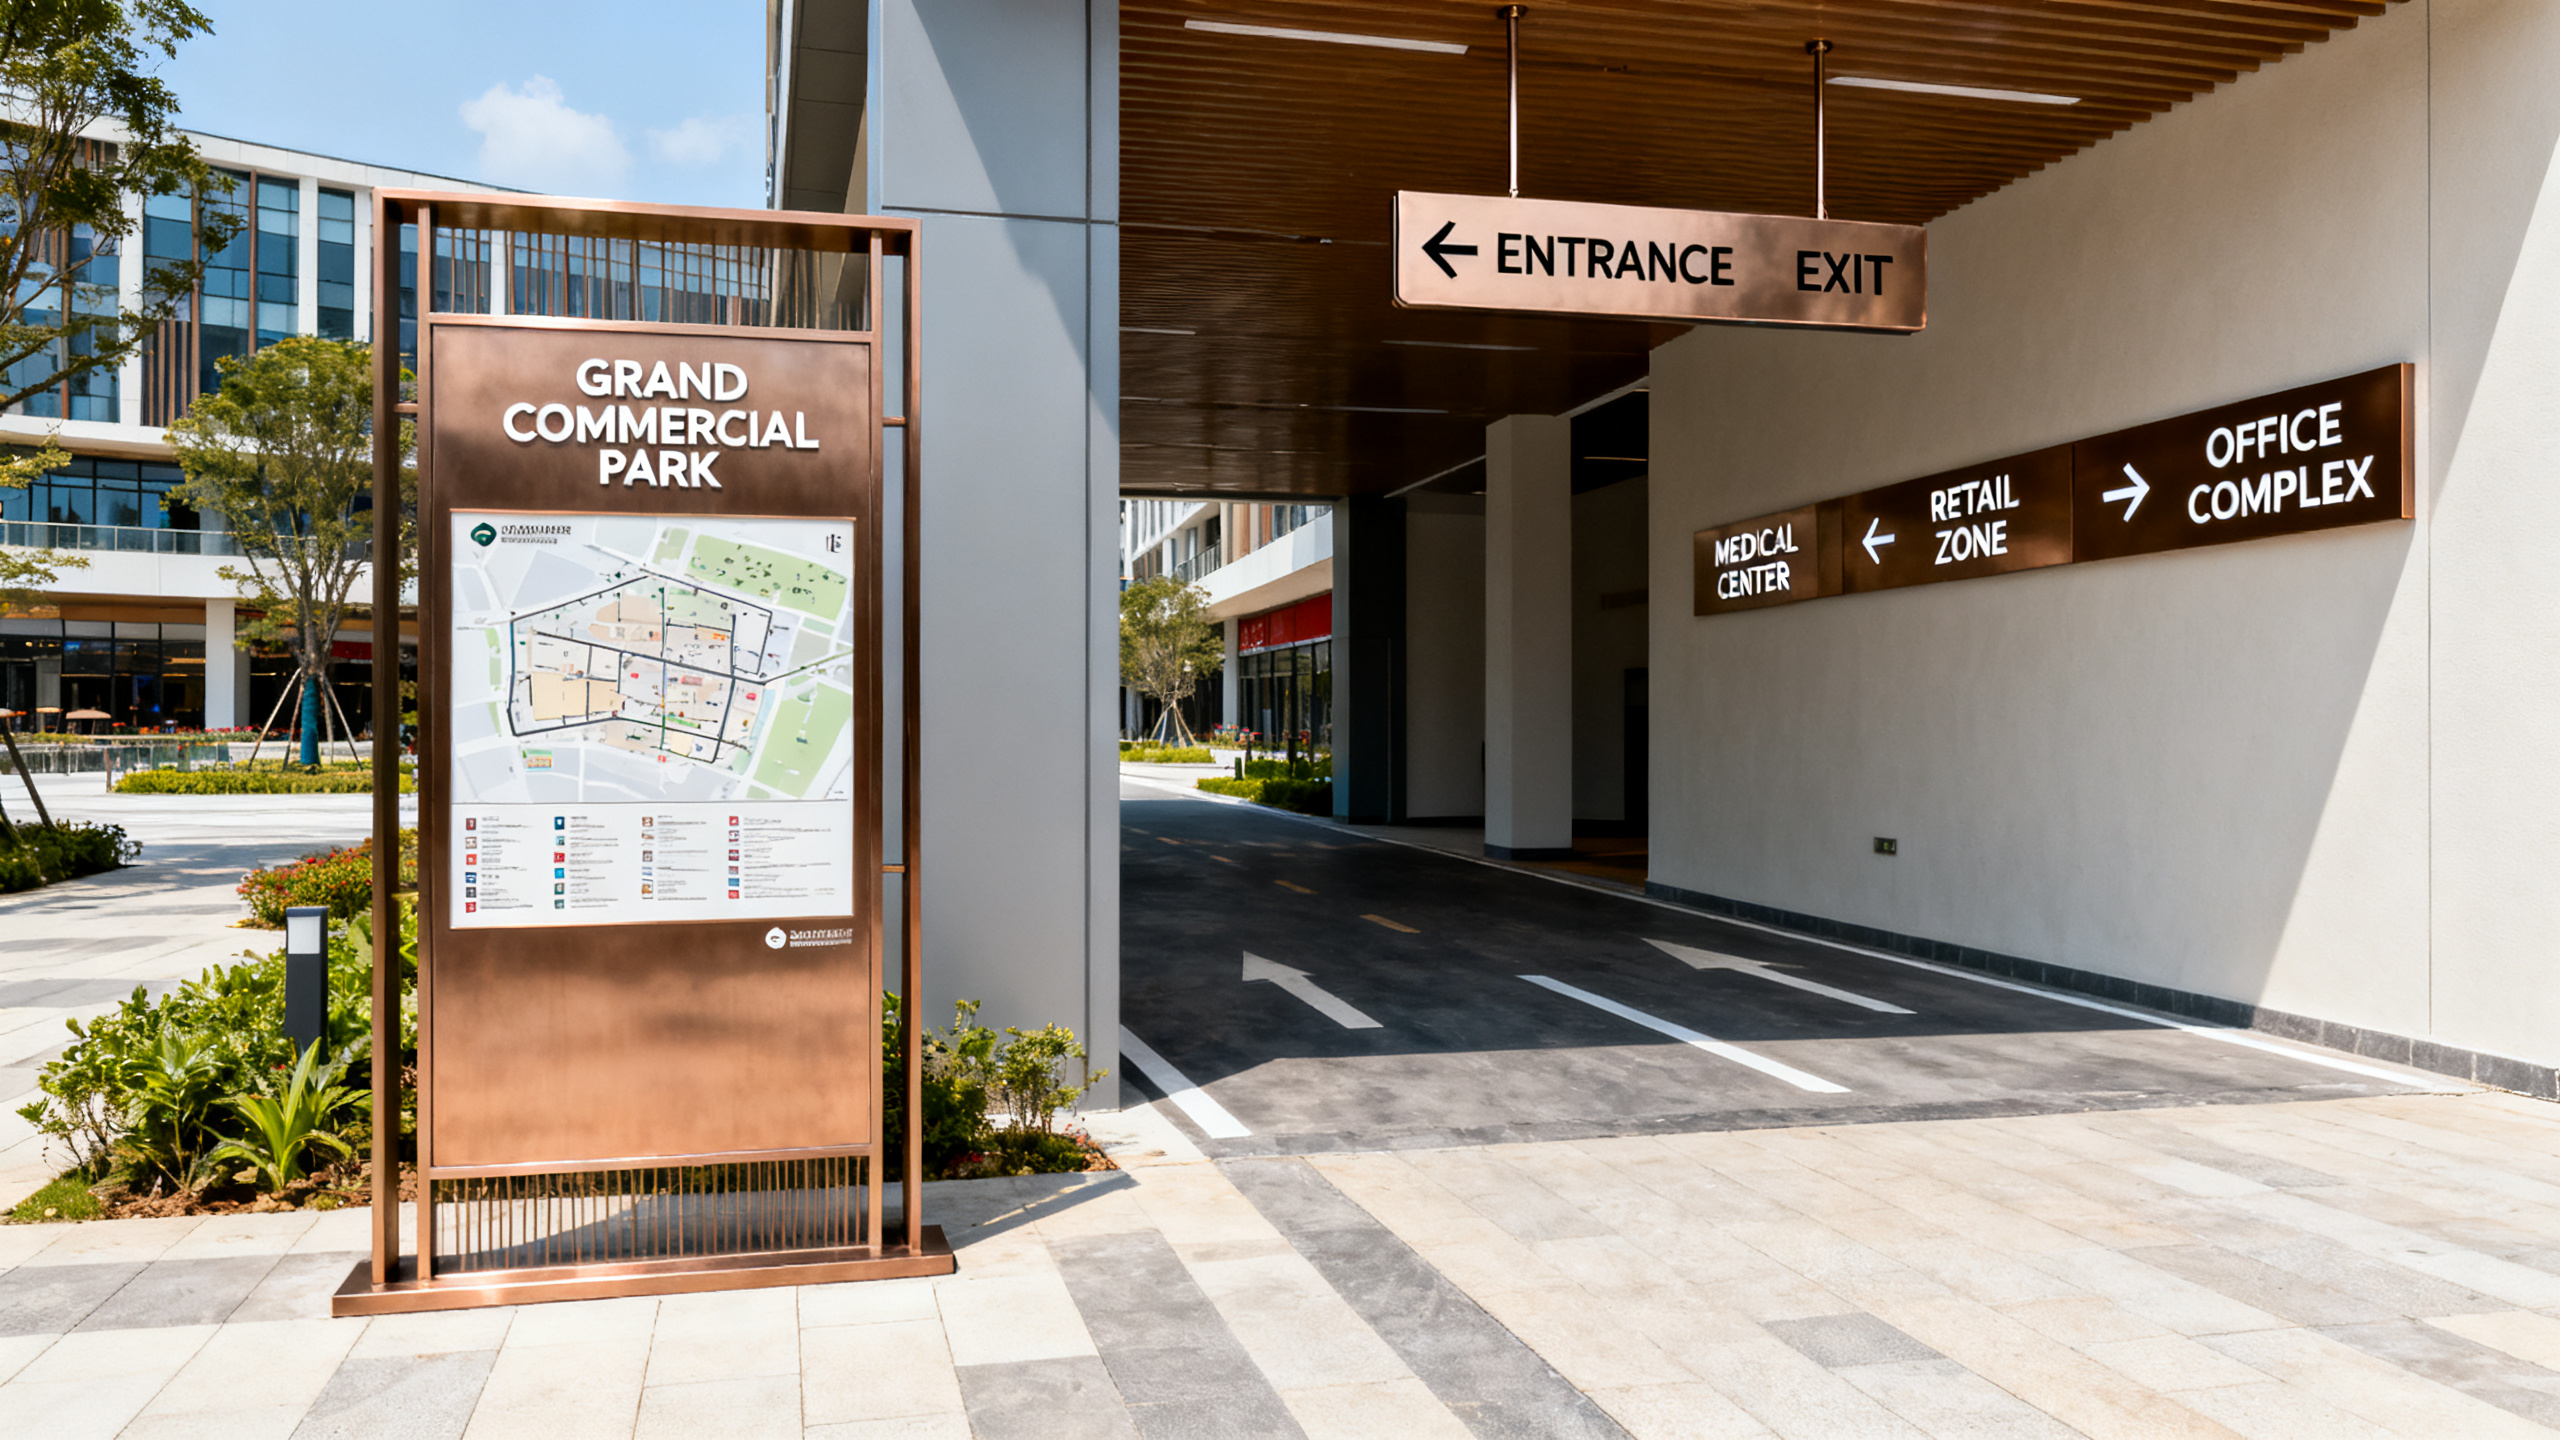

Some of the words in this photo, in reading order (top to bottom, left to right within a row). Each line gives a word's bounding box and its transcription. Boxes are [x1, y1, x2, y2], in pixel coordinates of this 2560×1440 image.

[1497, 232, 1735, 287] ENTRANCE
[1796, 250, 1894, 296] EXIT
[575, 357, 748, 401] GRAND
[502, 401, 820, 449] COMMERCIAL
[2206, 402, 2342, 468] OFFICE
[599, 448, 722, 488] PARK
[2188, 455, 2375, 524] COMPLEX
[1930, 474, 2020, 523] RETAIL
[1714, 522, 1799, 567] MEDICAL
[1934, 519, 2008, 565] ZONE
[1716, 560, 1791, 600] CENTER
